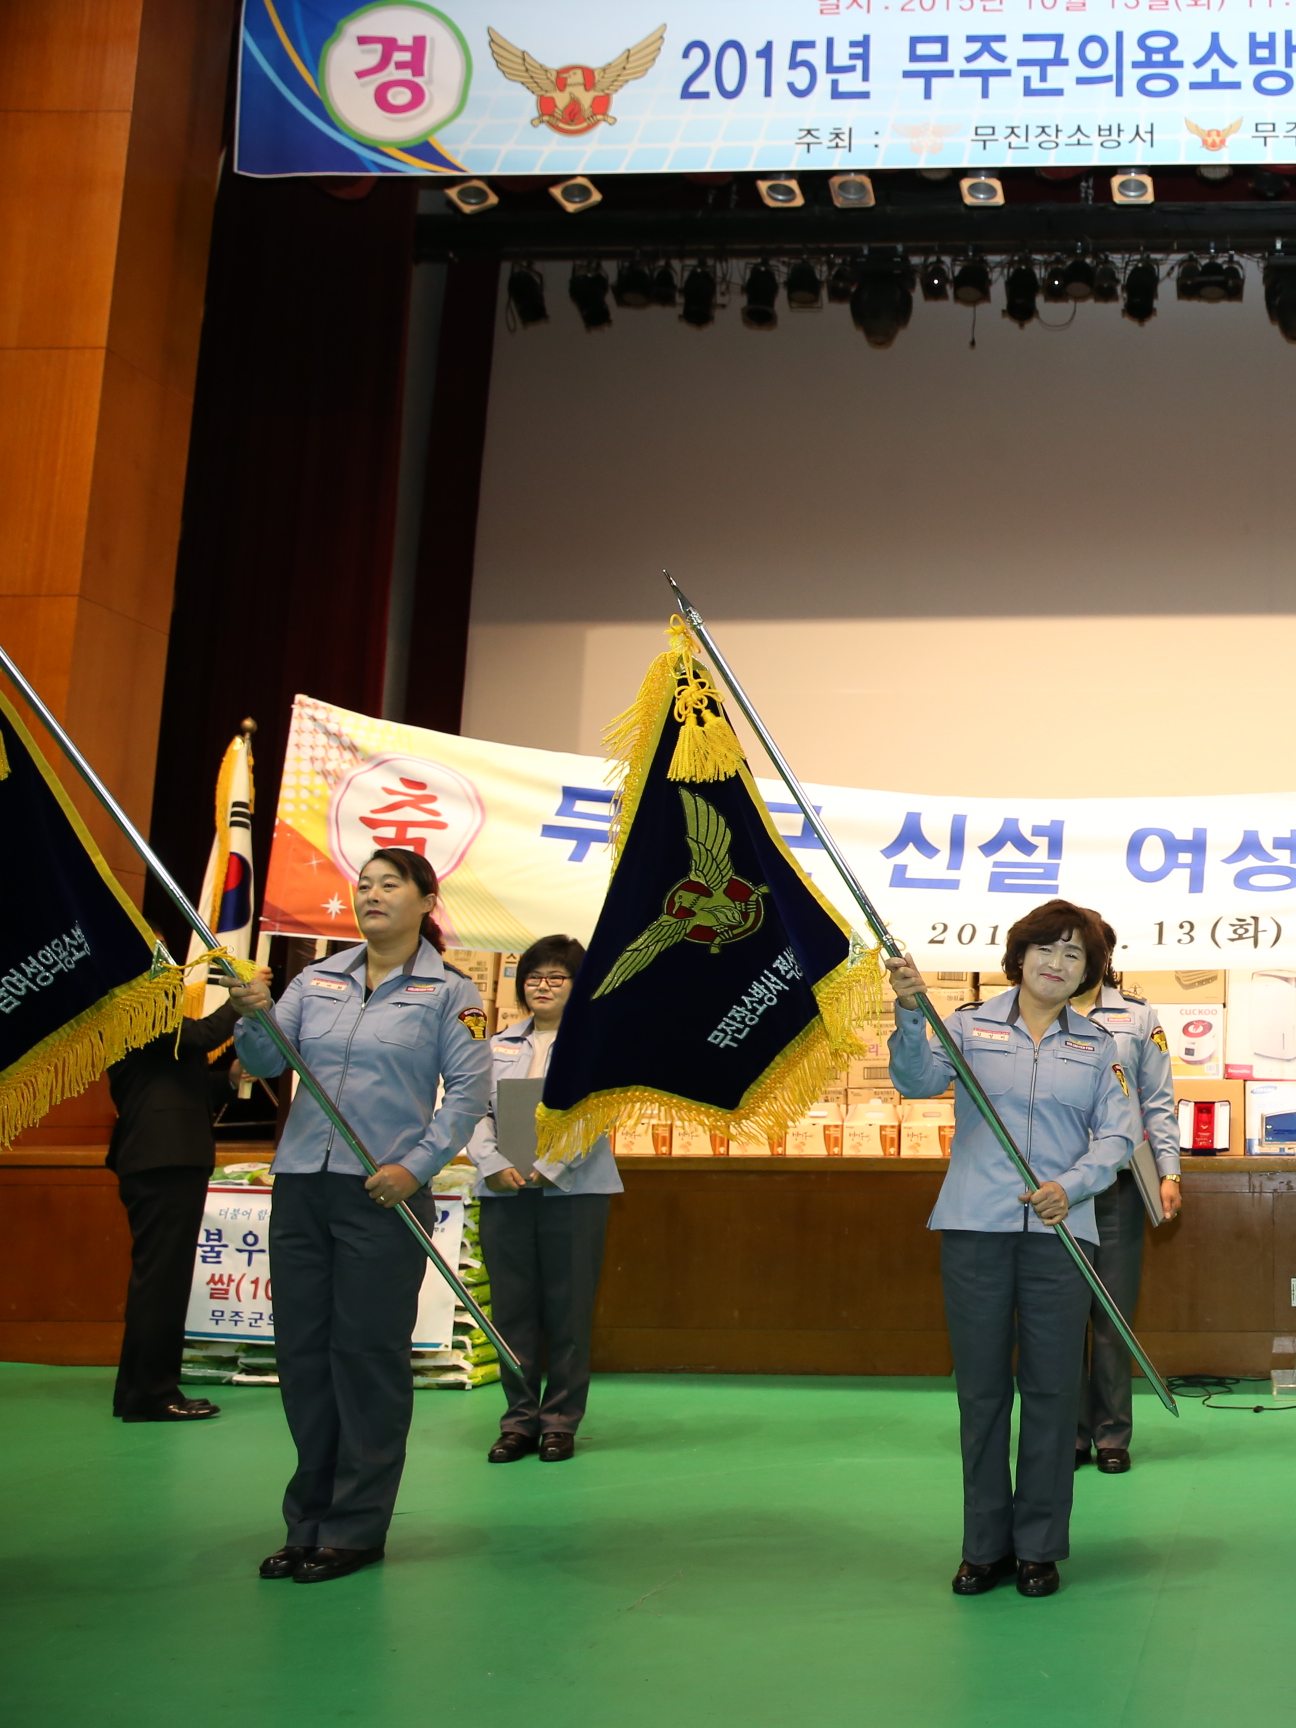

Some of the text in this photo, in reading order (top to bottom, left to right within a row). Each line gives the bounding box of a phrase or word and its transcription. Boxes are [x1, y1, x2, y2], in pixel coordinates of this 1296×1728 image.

[355, 34, 427, 116] 경
[680, 34, 872, 101] 2015년
[794, 126, 853, 153] 주최
[970, 122, 1156, 151] 무진장소방서
[359, 777, 449, 857] 축
[880, 811, 1066, 895] 신설
[928, 921, 1000, 946] 201
[706, 968, 790, 1049] 무진장소방서
[1179, 1008, 1218, 1016] CUCKOO
[218, 1207, 253, 1221] 더불어
